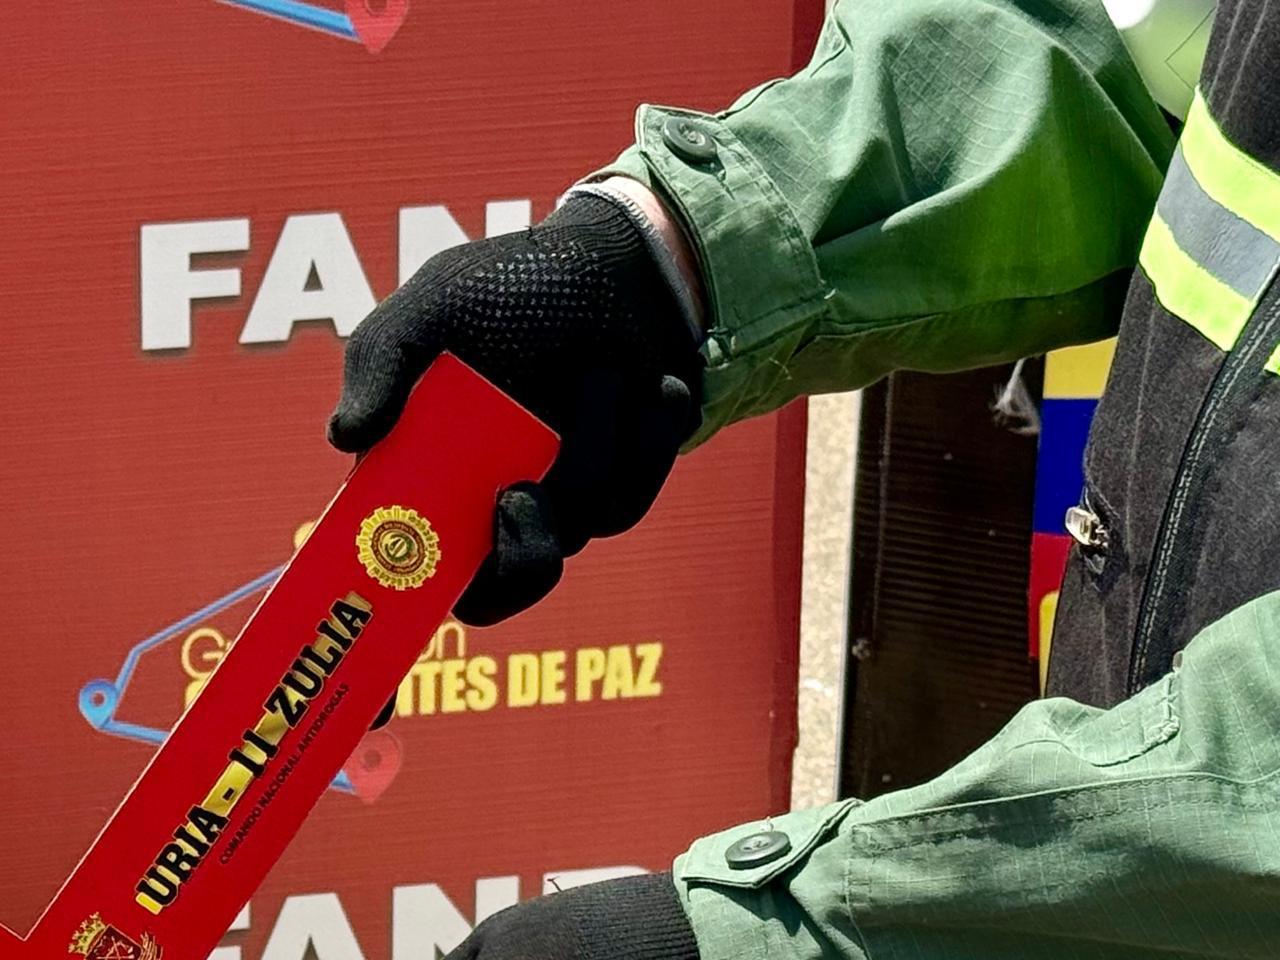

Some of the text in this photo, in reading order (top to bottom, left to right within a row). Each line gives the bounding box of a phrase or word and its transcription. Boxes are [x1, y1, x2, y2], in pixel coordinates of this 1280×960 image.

[135, 805, 230, 906] URIA
[263, 598, 373, 729] ZULIA
[508, 651, 567, 708] DE
[575, 643, 662, 700] PAZ
[219, 683, 350, 865] COMANDO NACIONAL ANTIDROGAS
